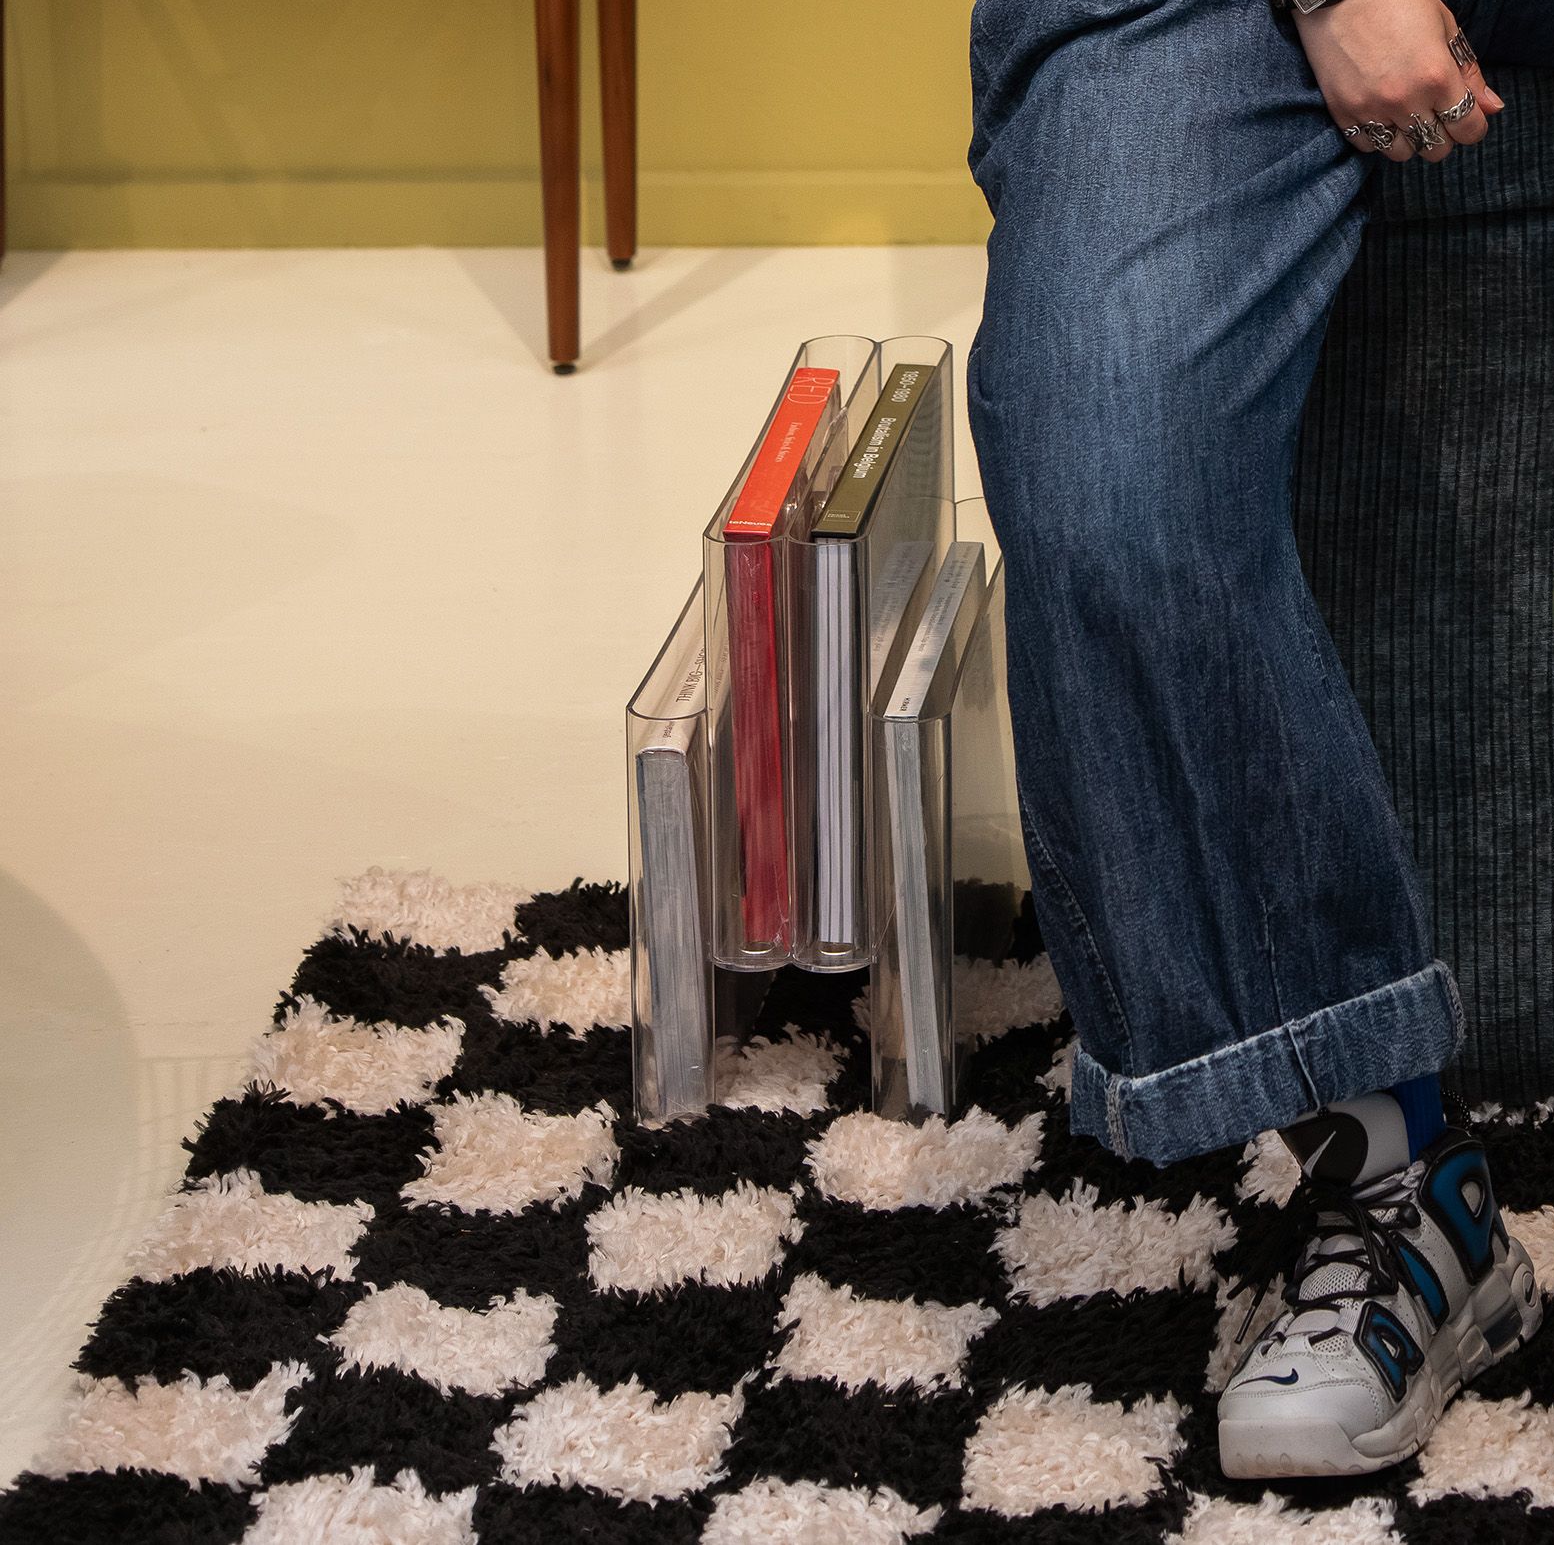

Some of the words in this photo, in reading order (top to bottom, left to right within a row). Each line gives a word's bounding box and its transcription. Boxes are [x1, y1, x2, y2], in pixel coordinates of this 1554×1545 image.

[869, 417, 897, 446] Brutalism
[853, 452, 880, 479] Belgium
[675, 682, 698, 703] THINK
